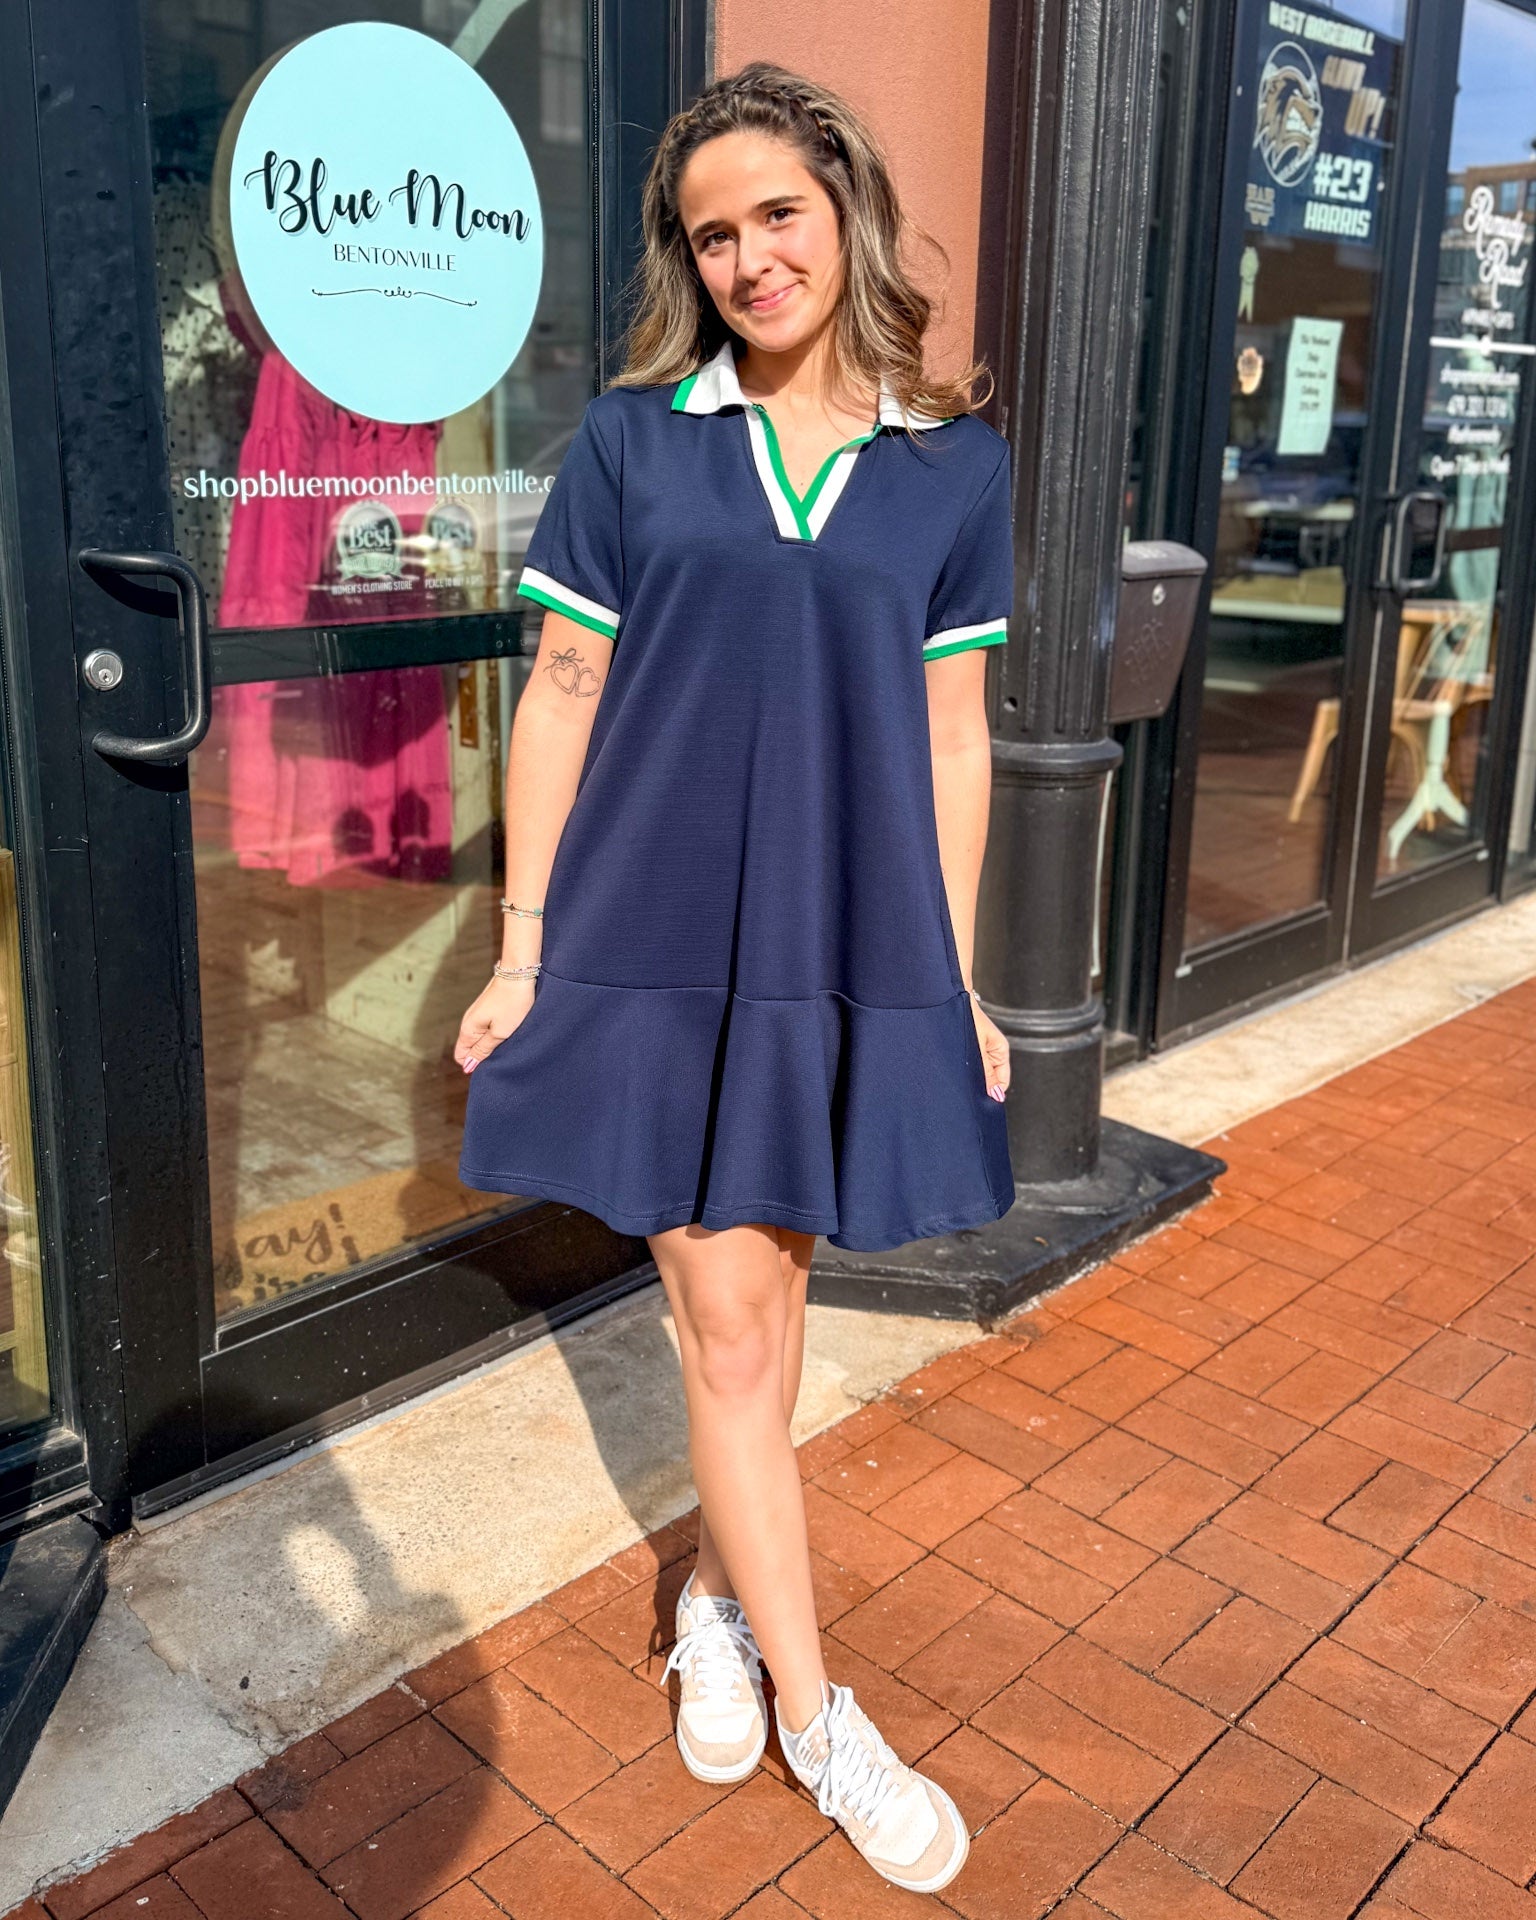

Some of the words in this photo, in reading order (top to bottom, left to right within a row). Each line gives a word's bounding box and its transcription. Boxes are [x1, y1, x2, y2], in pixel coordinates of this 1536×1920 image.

[244, 150, 381, 234] Blue
[389, 169, 530, 240] Moon
[1313, 152, 1373, 203] #23
[1303, 200, 1372, 238] HARRIS
[334, 243, 457, 272] BENTONVILLE
[184, 468, 556, 505] shopbluemoonbentonville.c
[349, 523, 393, 550] Best
[363, 581, 393, 593] CLOTHING
[393, 580, 413, 591] STORE
